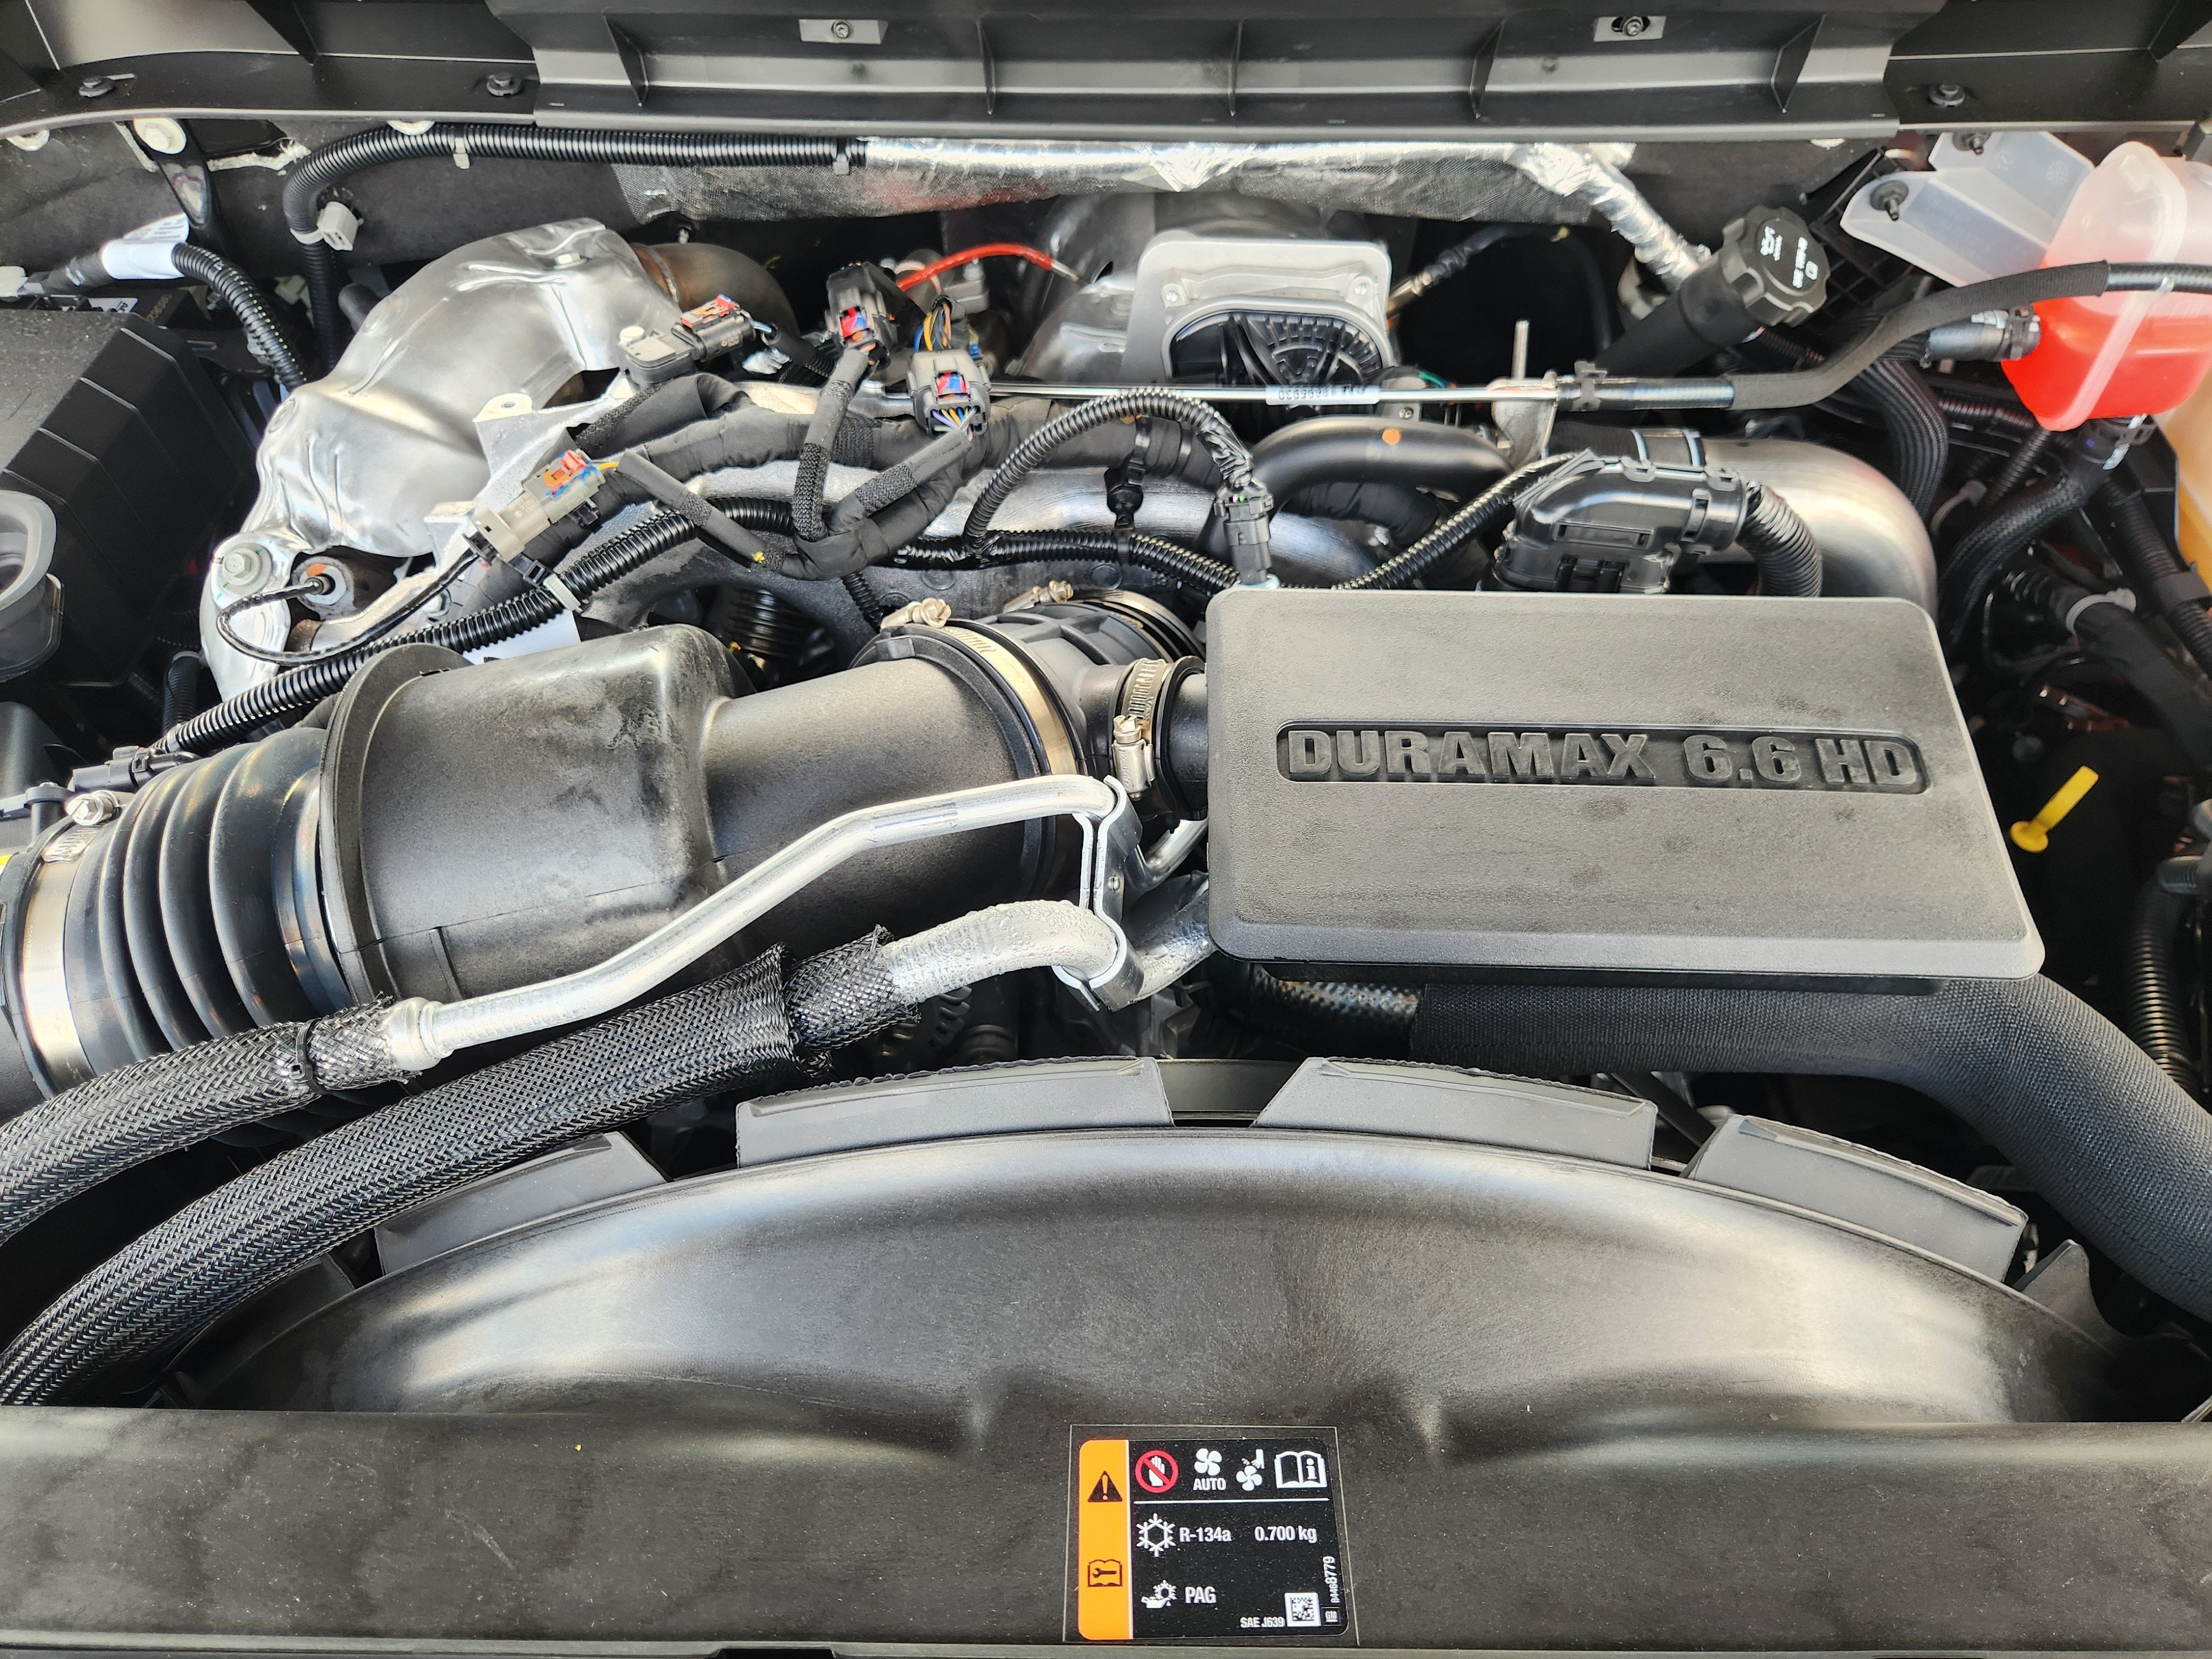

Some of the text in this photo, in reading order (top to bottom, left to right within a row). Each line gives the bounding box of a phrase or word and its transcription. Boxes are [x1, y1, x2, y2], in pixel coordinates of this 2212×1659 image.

[1287, 730, 1918, 786] DURAMAX 6.6 HD
[1193, 1477, 1227, 1491] AUTO
[1179, 1525, 1317, 1543] R-134a 0.700 kg
[1323, 1556, 1341, 1603] 84468779
[1185, 1586, 1217, 1604] PAG
[1240, 1617, 1285, 1627] SAE J639
[1325, 1610, 1338, 1619] GM
